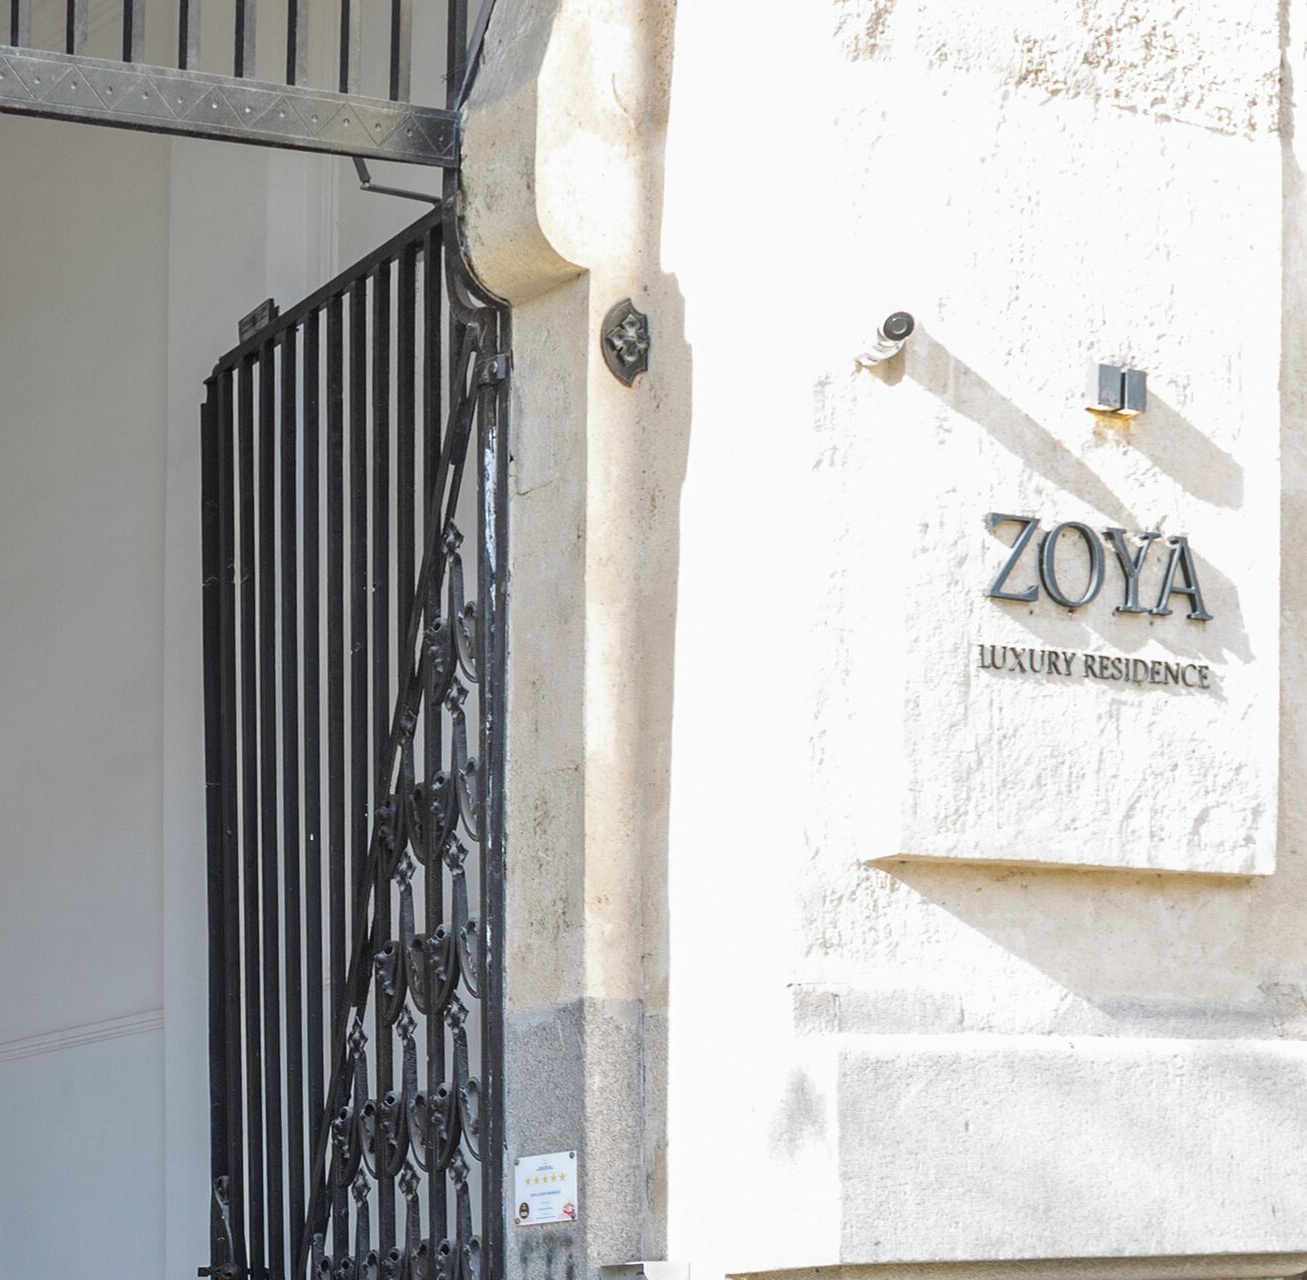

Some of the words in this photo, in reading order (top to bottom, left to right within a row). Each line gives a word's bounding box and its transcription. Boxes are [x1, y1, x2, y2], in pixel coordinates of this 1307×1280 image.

[985, 512, 1214, 621] ZOYA
[977, 644, 1076, 676] LUXURY
[1083, 653, 1210, 689] RESIDENCE
